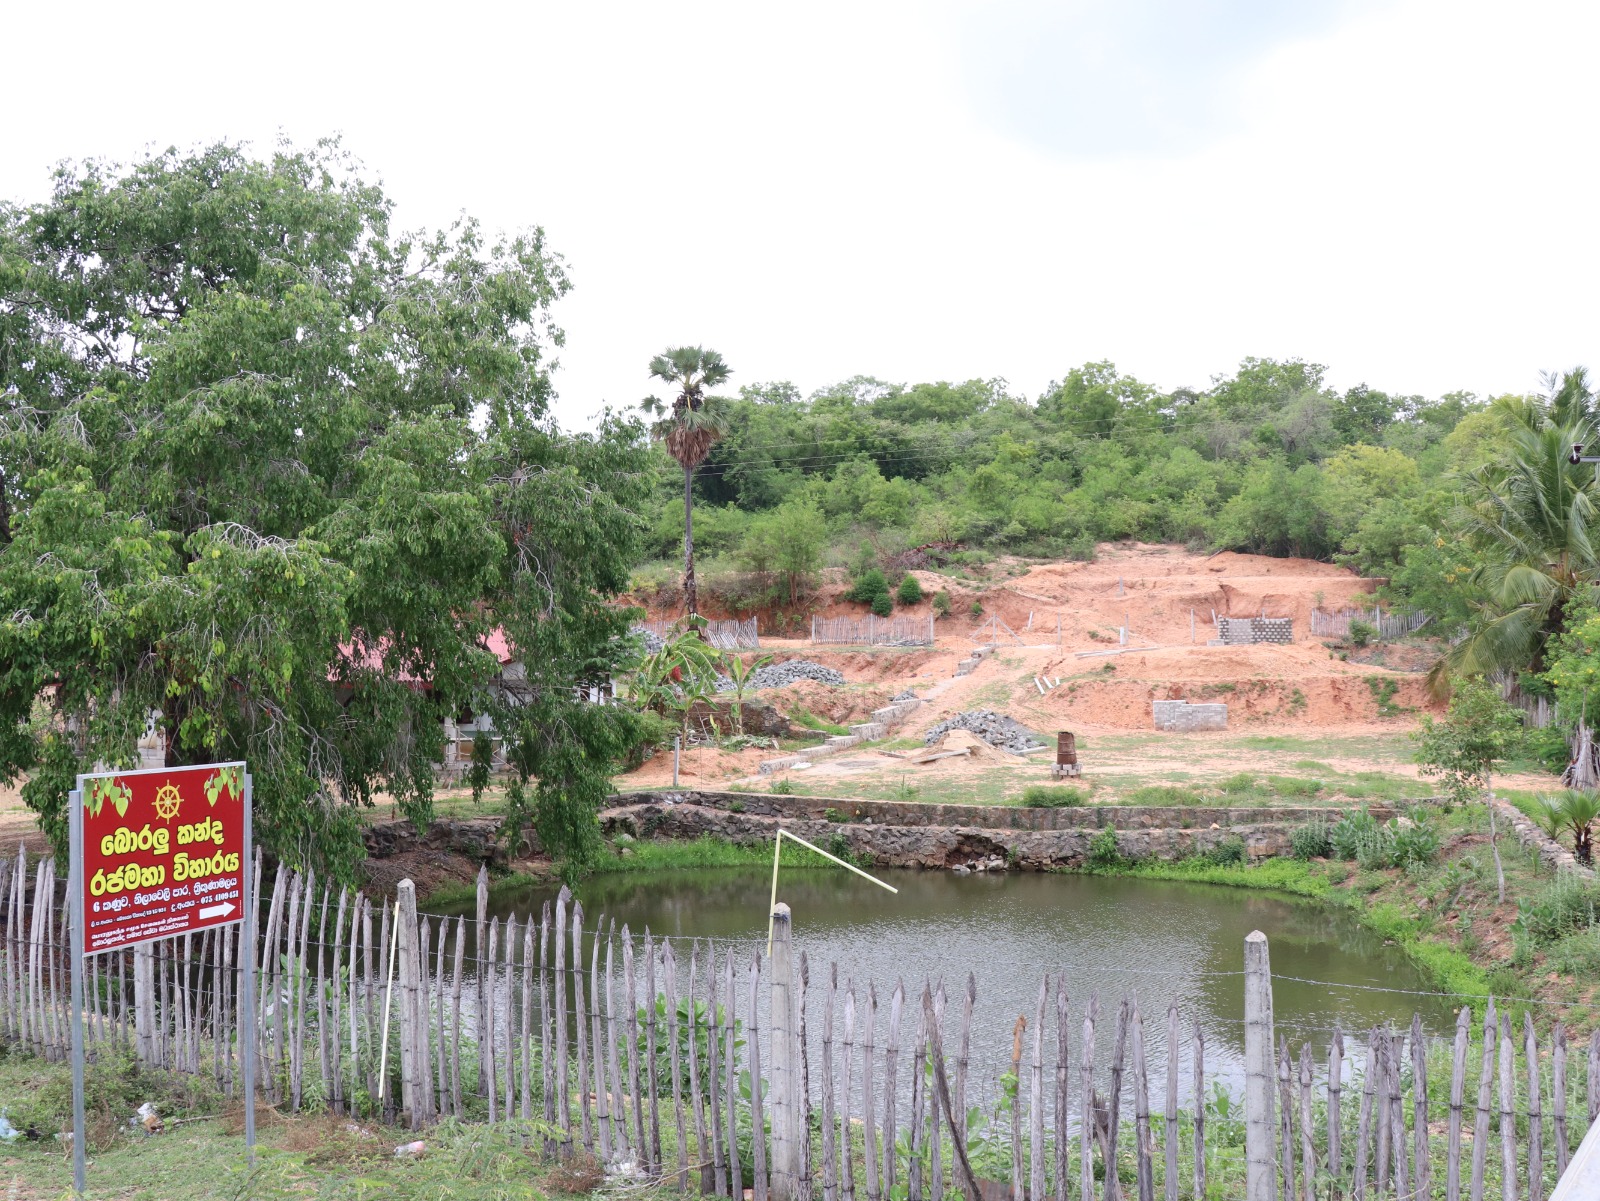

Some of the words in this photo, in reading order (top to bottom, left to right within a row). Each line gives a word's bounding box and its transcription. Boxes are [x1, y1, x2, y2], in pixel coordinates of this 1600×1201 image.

[101, 824, 170, 857] බොරලු
[177, 816, 225, 846] කන්ද
[90, 862, 165, 897] රජමහා
[173, 850, 240, 883] විහාරය
[93, 902, 100, 912] 6
